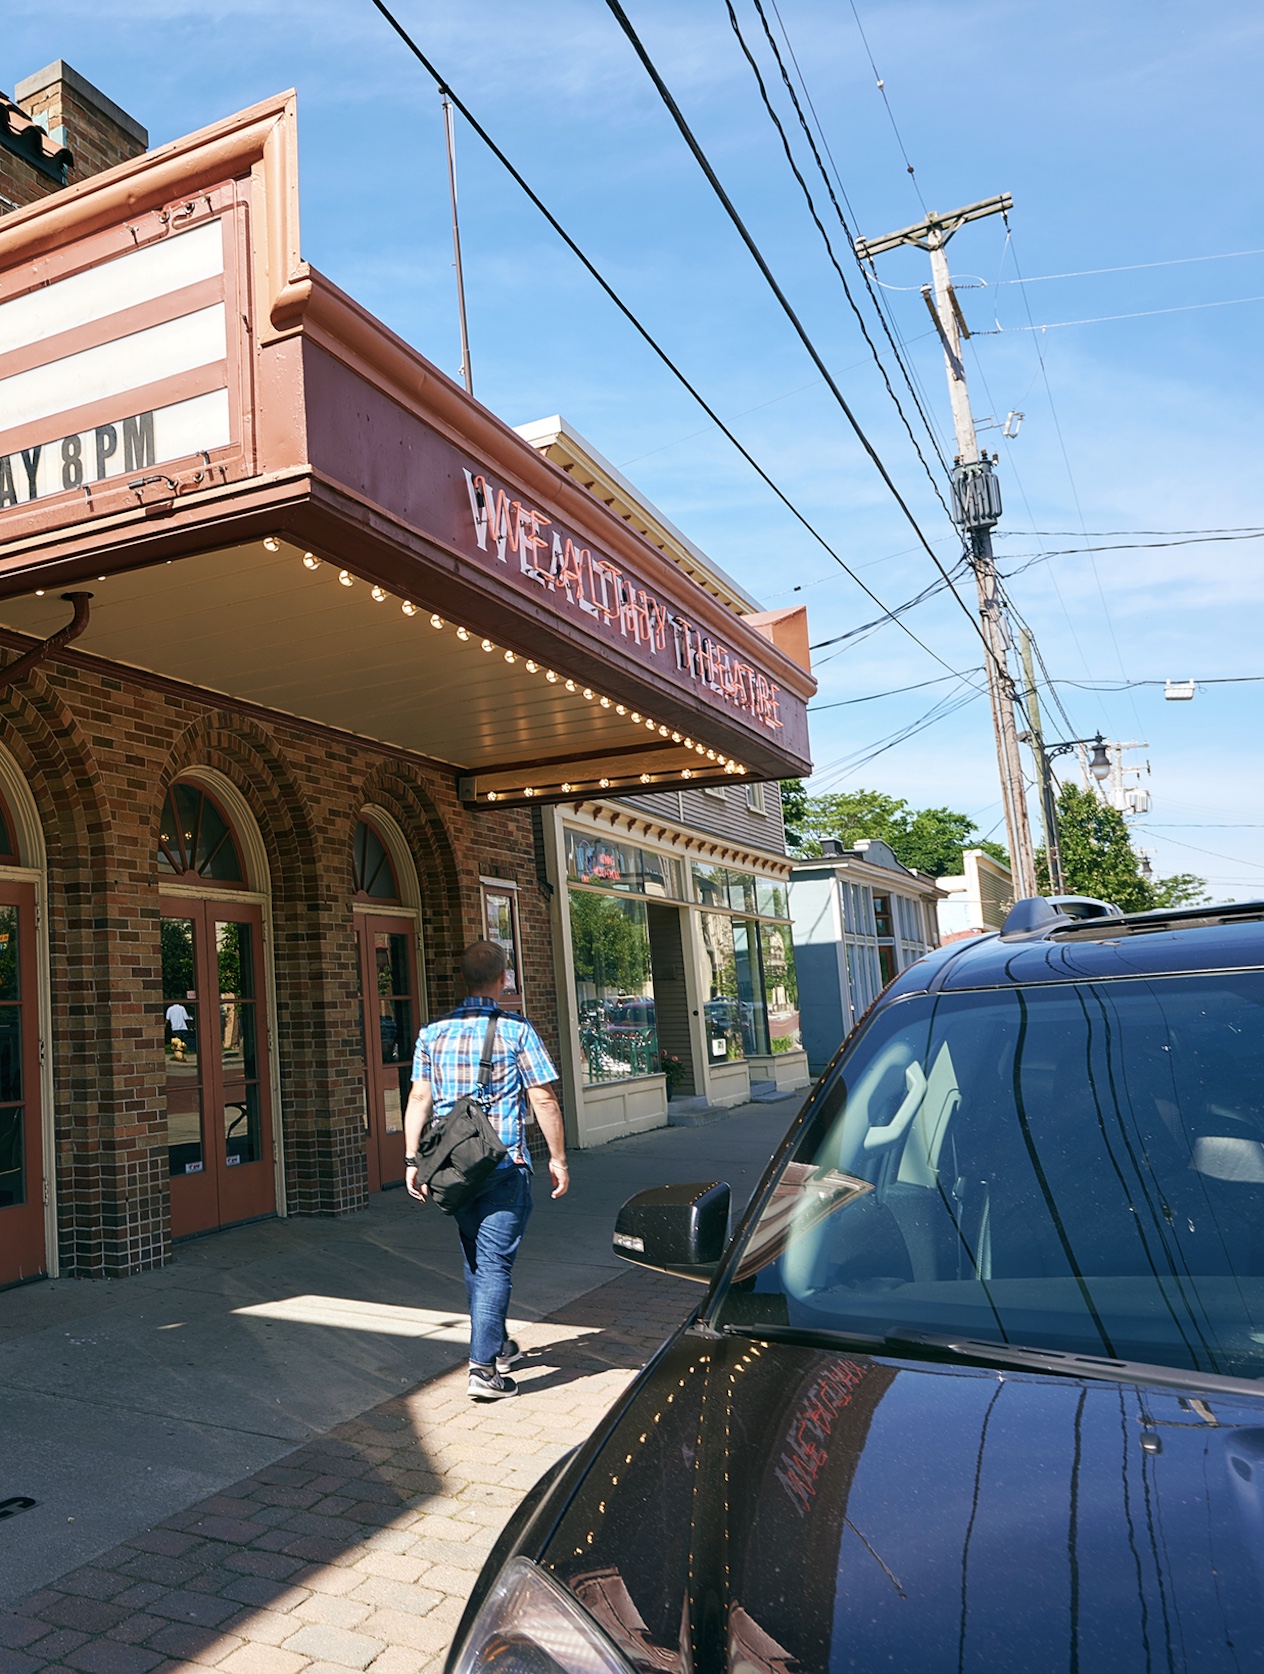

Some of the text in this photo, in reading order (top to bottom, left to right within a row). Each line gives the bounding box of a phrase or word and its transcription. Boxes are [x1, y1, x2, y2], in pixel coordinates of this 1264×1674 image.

[61, 434, 83, 490] 8
[96, 411, 156, 480] PM
[462, 467, 784, 730] WEALTHY THEATRE
